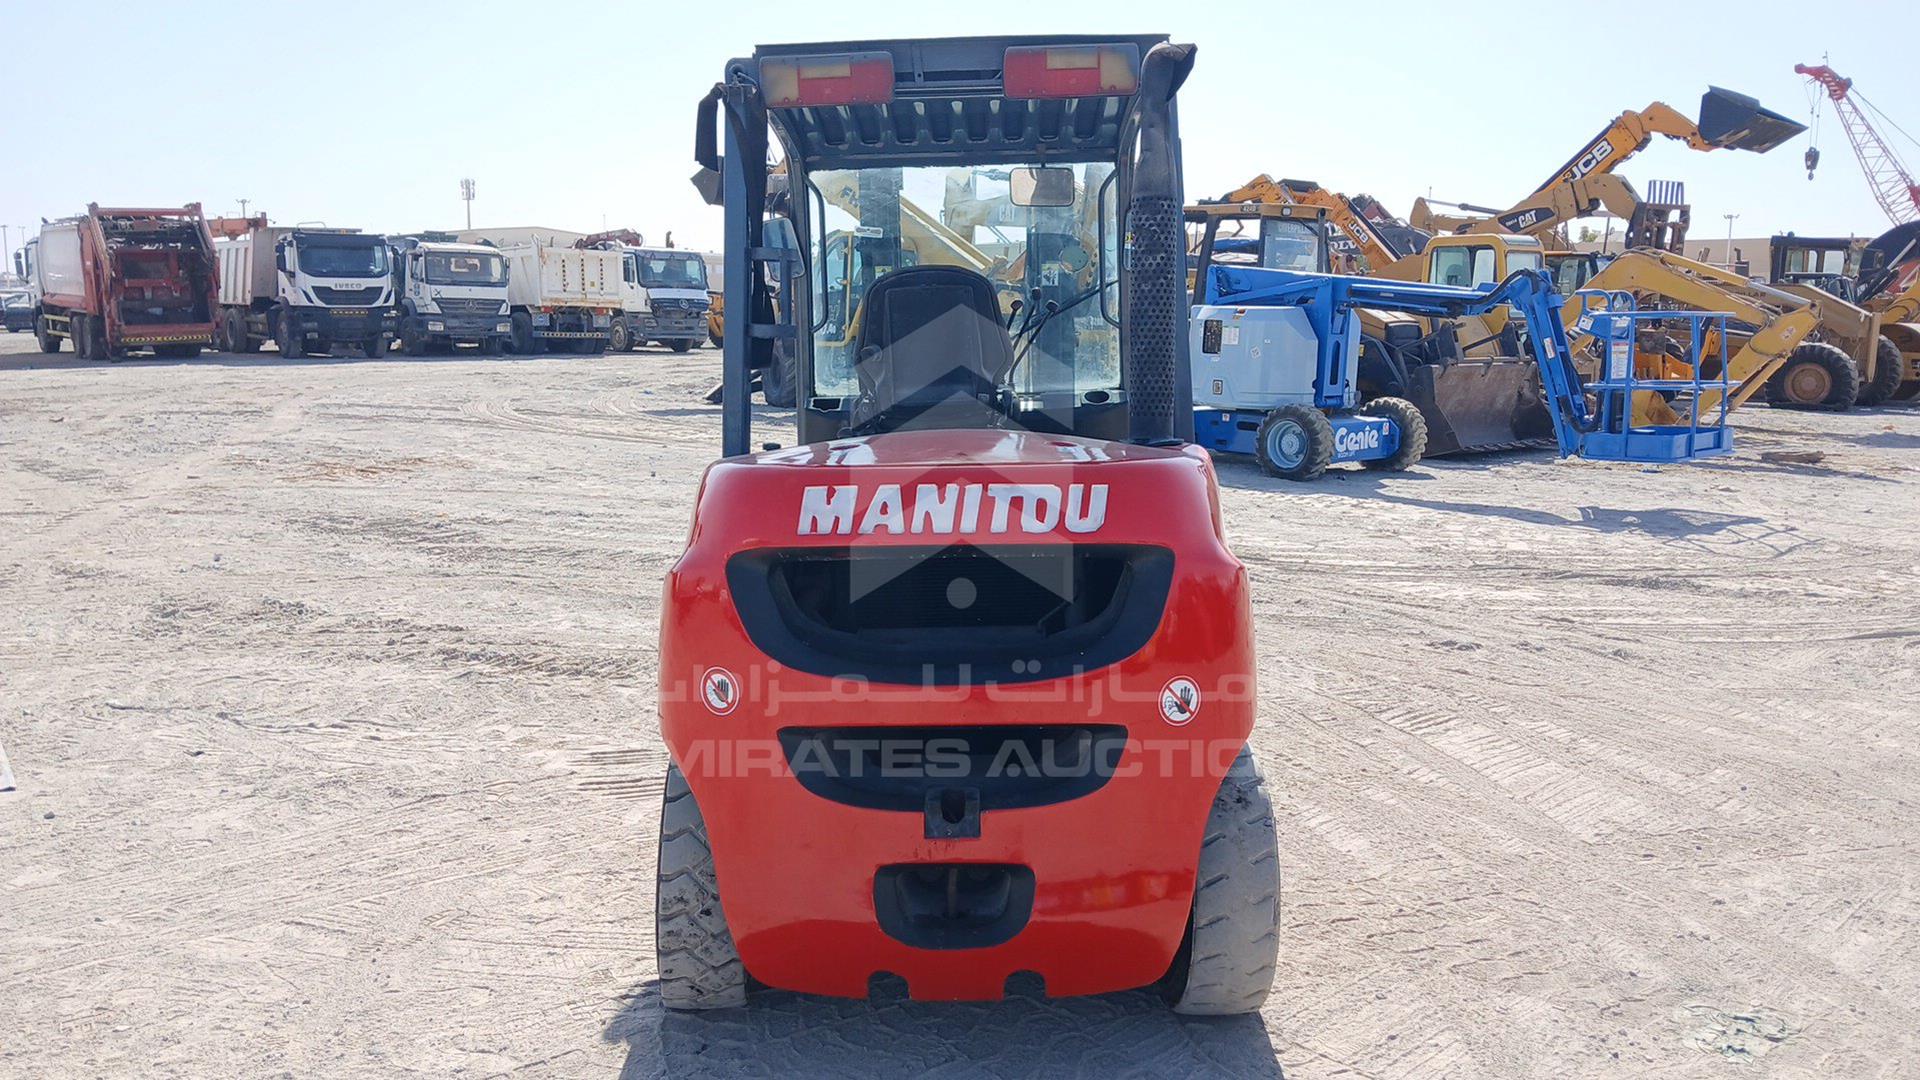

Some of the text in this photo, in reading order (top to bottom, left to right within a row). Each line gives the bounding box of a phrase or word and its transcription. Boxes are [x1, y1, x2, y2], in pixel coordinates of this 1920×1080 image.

[1571, 140, 1613, 182] JCB
[1518, 209, 1537, 228] CAT
[1348, 222, 1369, 244] JCB
[334, 282, 362, 290] IVECO
[1335, 424, 1379, 453] Genie
[797, 483, 1109, 536] MANITOU
